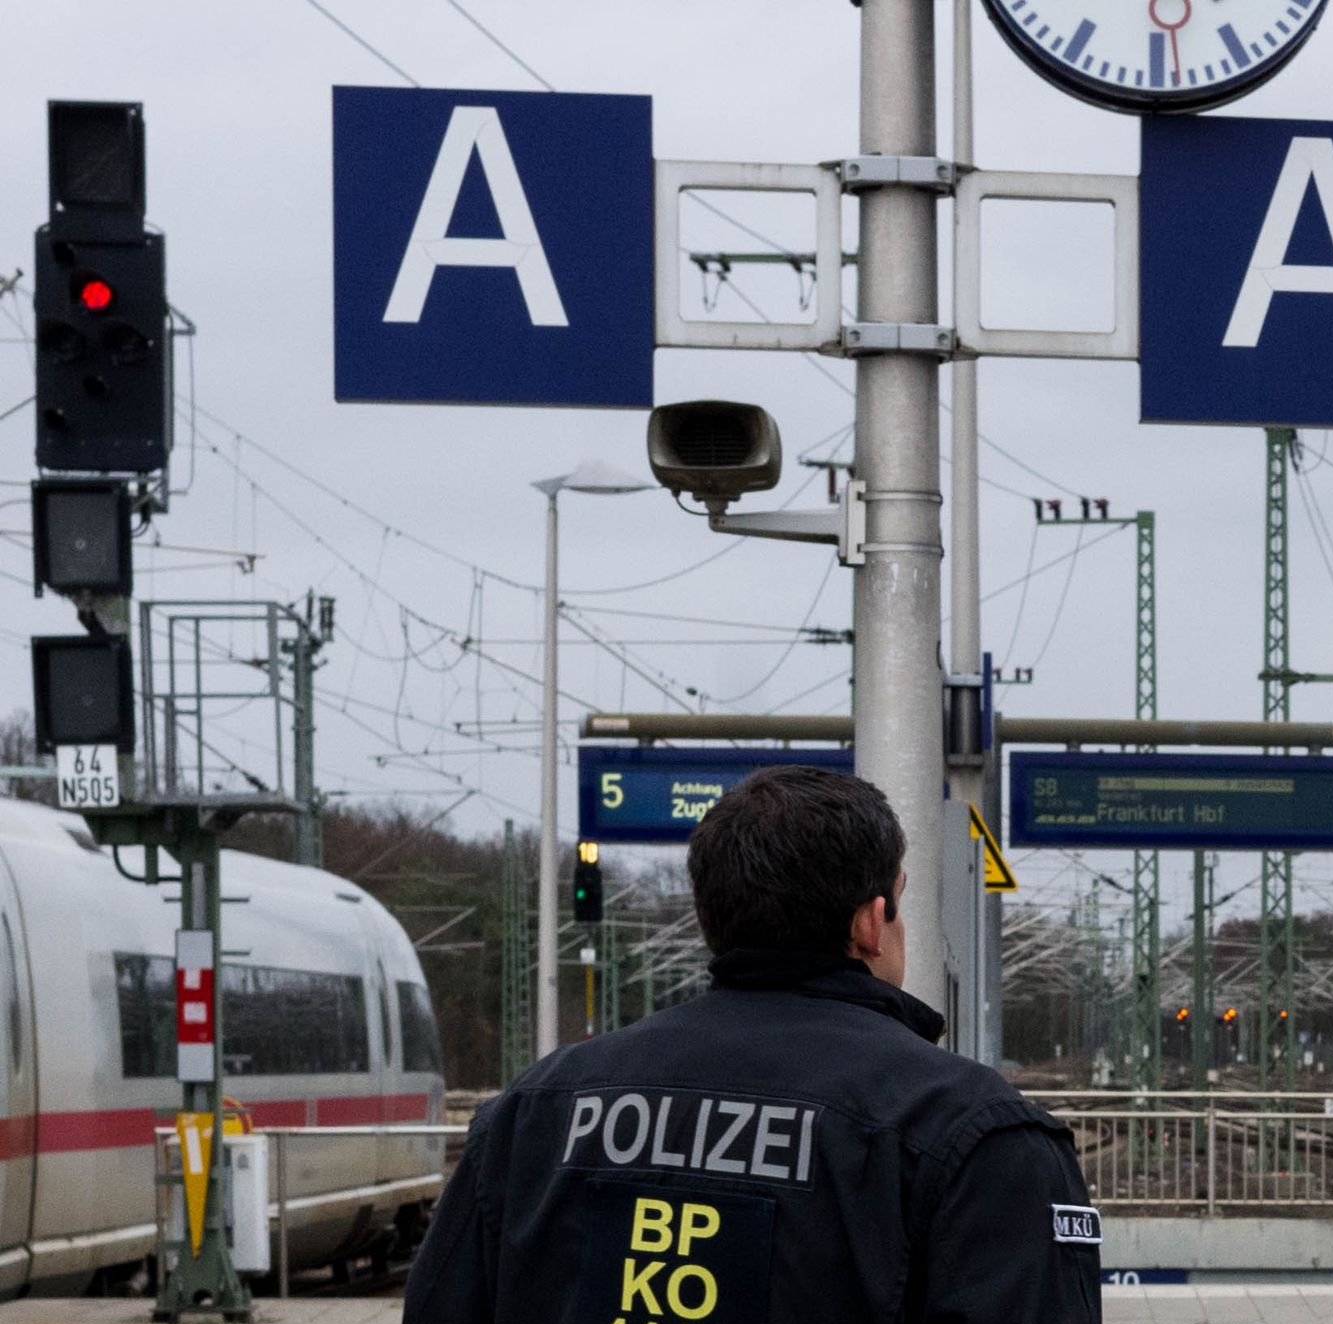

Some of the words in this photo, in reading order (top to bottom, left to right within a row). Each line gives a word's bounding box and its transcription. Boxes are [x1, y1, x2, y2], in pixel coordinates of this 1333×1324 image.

[383, 106, 569, 327] A
[63, 777, 114, 802] N505
[602, 773, 624, 808] 5
[672, 782, 722, 798] Achtung
[1097, 803, 1185, 823] Frankfurt
[1193, 804, 1225, 823] Hbf
[563, 1093, 816, 1182] POLIZEI
[630, 1197, 721, 1256] BP
[621, 1258, 718, 1319] KO
